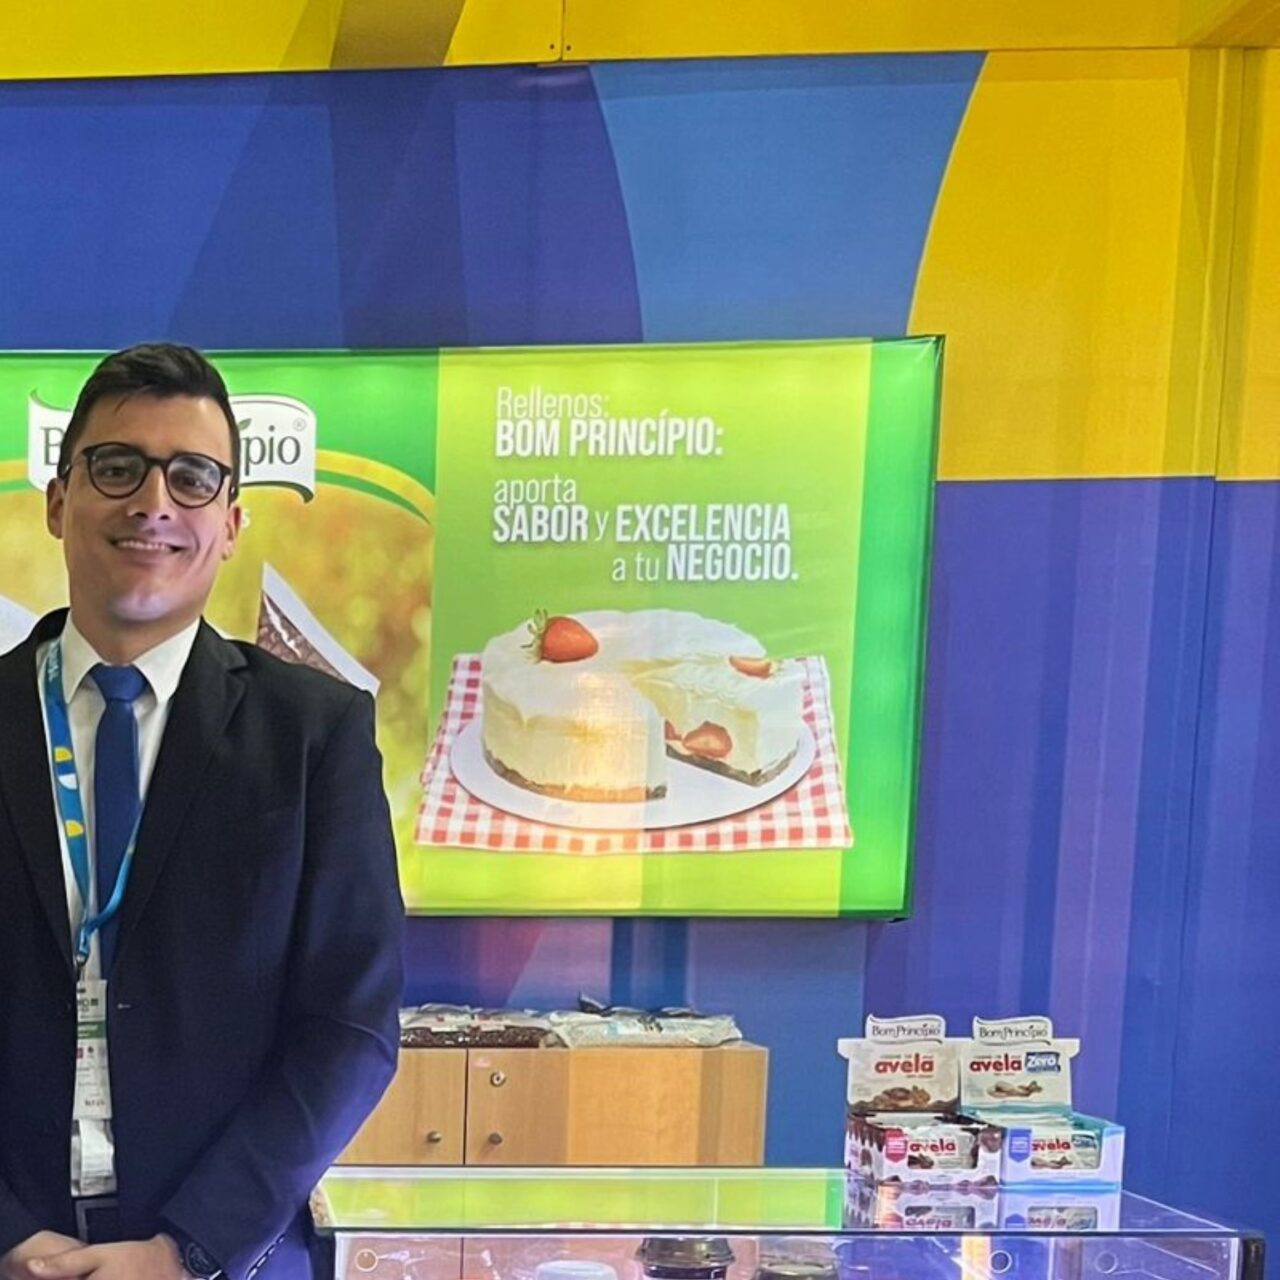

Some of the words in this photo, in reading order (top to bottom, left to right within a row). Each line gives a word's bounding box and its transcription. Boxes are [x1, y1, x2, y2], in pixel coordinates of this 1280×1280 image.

[496, 386, 610, 420] Rellenos:
[495, 419, 560, 457] BOM
[569, 409, 724, 456] PRINCÍPIO:
[493, 474, 577, 510] aporta
[492, 504, 588, 542] SABOR
[594, 510, 610, 541] y
[616, 503, 791, 543] EXCELENCIA
[612, 556, 626, 581] a
[634, 552, 659, 581] tu
[667, 543, 799, 581] NEGOCIO.
